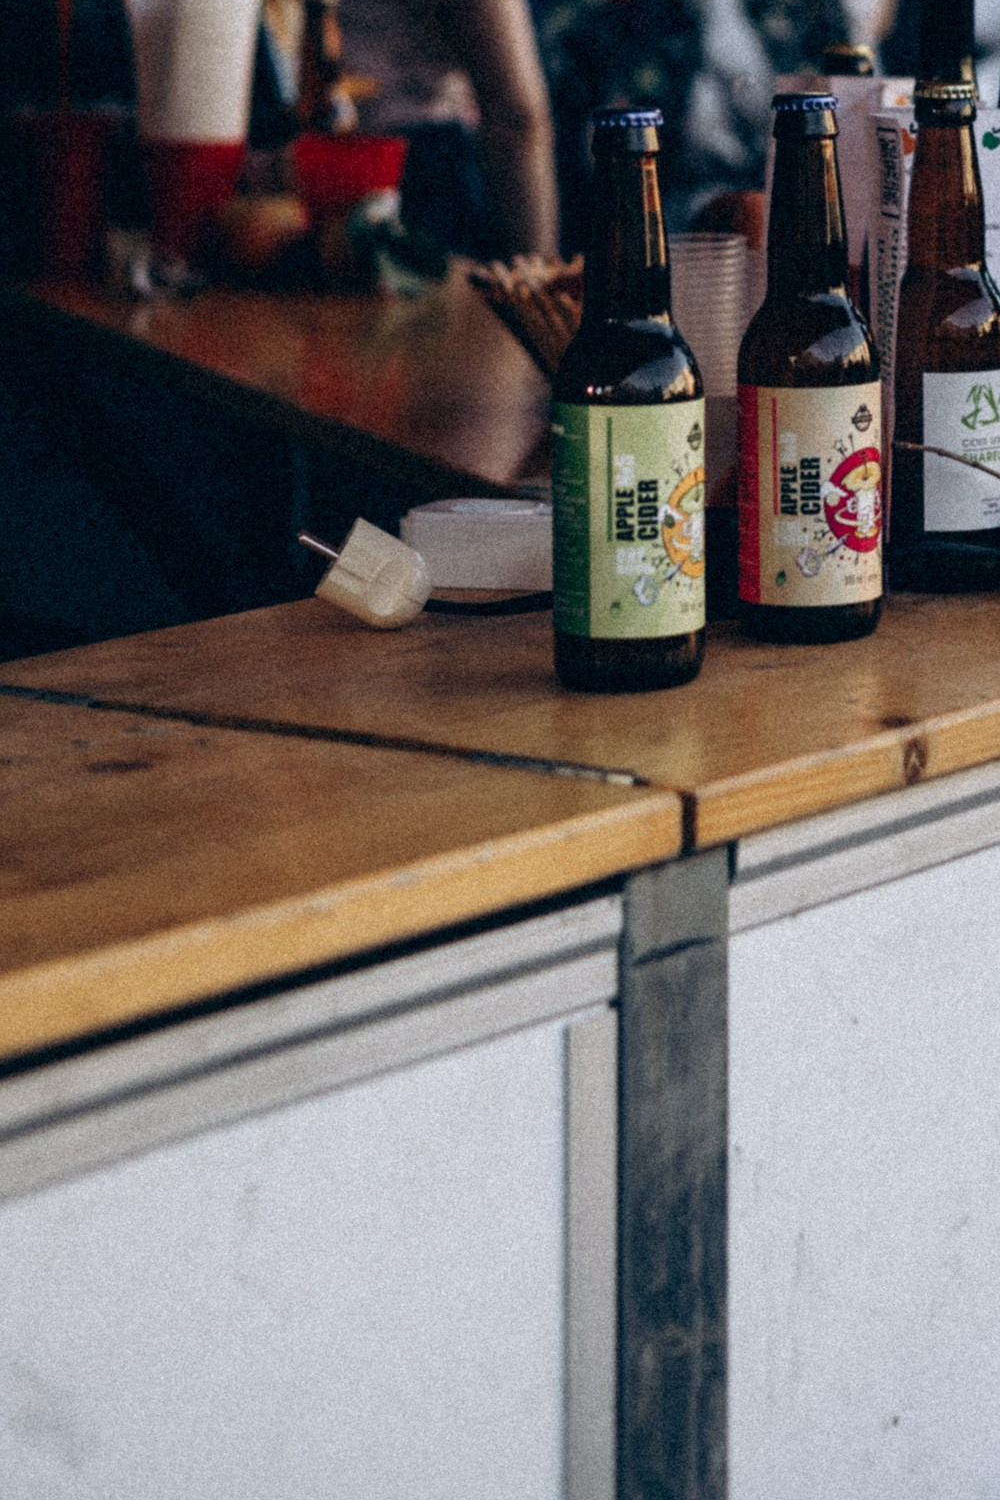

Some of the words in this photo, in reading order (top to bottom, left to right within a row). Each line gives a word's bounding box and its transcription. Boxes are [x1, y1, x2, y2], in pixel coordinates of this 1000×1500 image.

[638, 479, 659, 541] CIDER
[780, 465, 798, 516] APPLE
[800, 457, 821, 516] CIDER
[616, 488, 635, 542] APPLE
